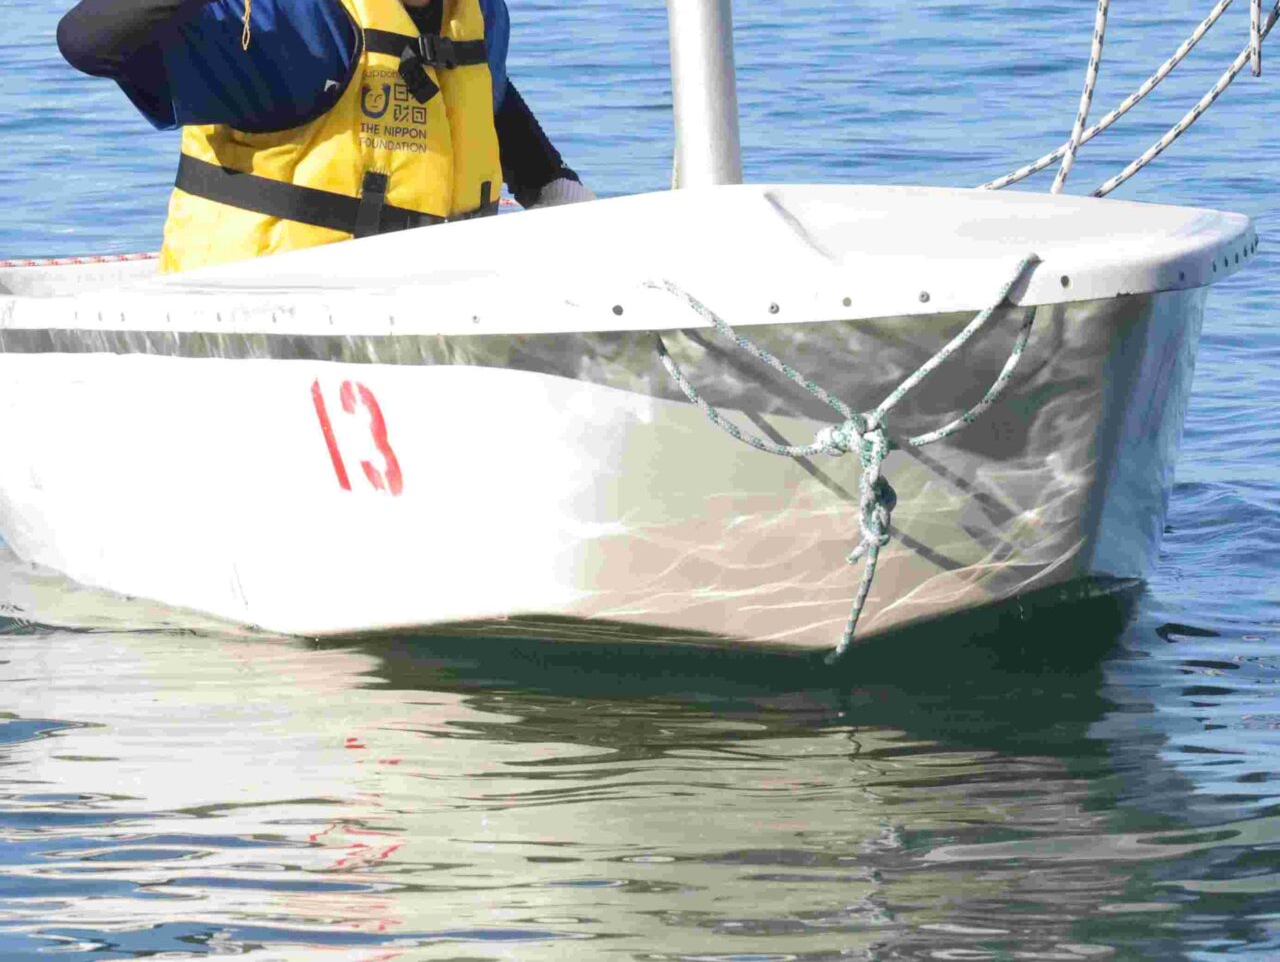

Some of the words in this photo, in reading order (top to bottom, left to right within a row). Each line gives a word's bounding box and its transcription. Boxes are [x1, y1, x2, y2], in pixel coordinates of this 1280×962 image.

[361, 123, 380, 135] THE
[384, 125, 427, 140] NIPPON
[359, 137, 427, 153] FOUNDATION
[311, 377, 404, 497] 13
